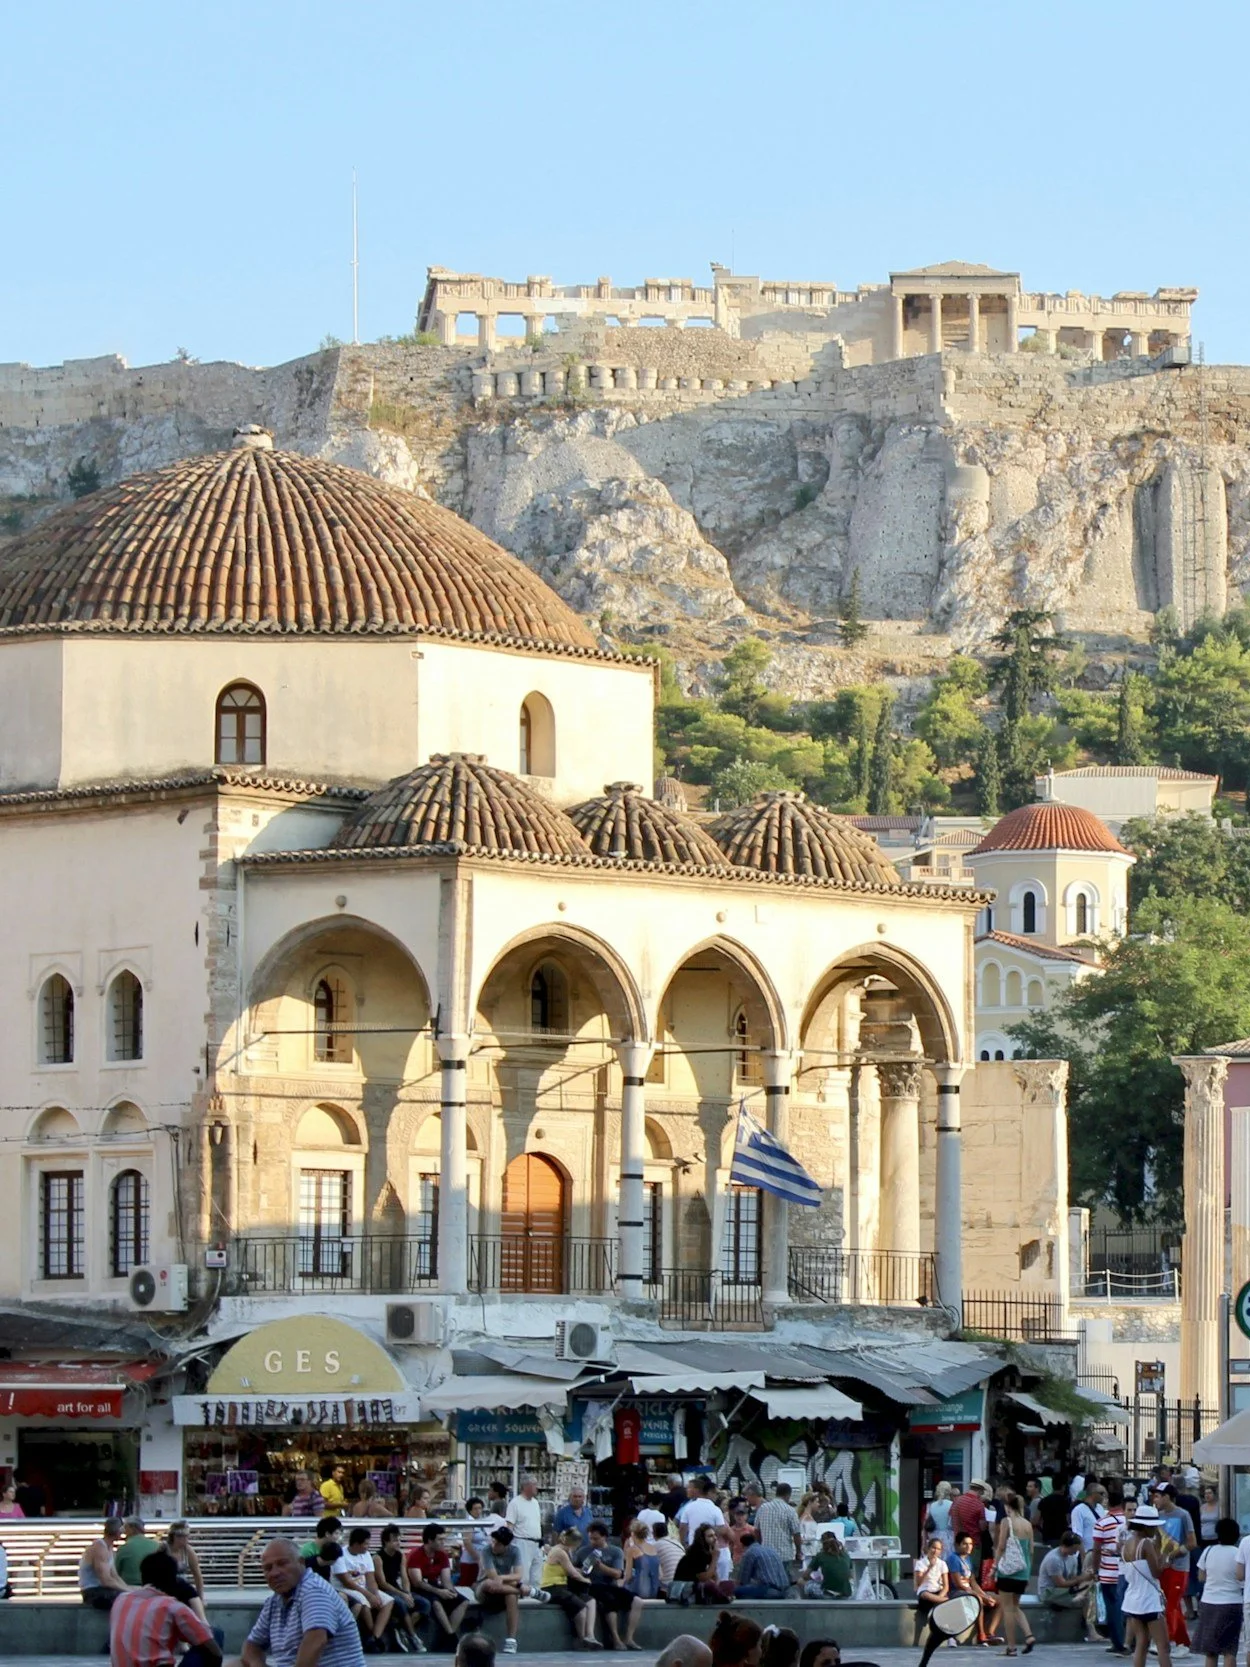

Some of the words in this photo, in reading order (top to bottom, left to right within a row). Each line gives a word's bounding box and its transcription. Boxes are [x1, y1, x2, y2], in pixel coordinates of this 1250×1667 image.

[264, 1350, 341, 1374] GES
[57, 1403, 74, 1413] art
[77, 1402, 94, 1413] for
[97, 1403, 112, 1413] all
[466, 1423, 498, 1433] GREEK
